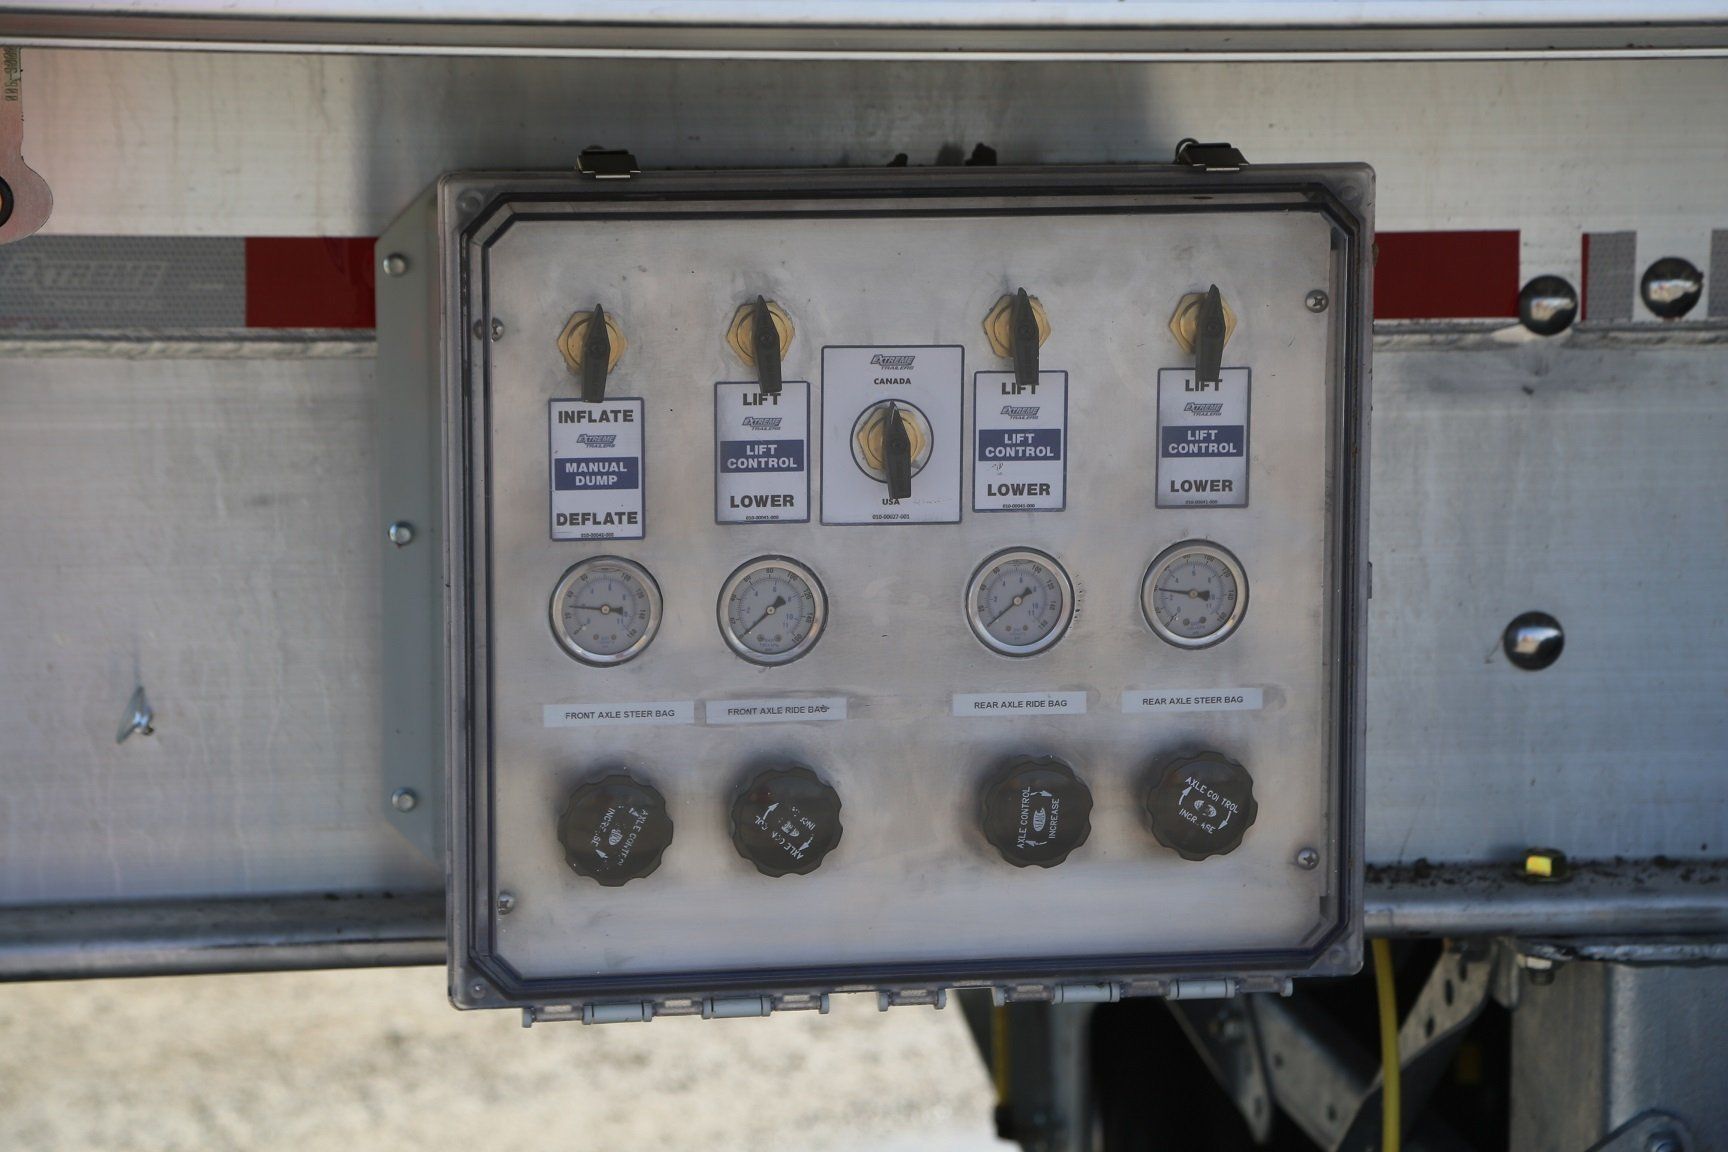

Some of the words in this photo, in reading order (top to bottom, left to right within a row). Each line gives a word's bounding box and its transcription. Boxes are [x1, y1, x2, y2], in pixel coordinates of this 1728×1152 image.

[871, 354, 915, 365] EXTREME
[1001, 382, 1037, 395] LIFT
[1185, 379, 1222, 392] LIFT
[742, 393, 781, 406] LIFT
[1000, 406, 1040, 416] EXTREME
[1184, 402, 1223, 412] EXTREME
[558, 410, 634, 424] INFLATE
[742, 417, 782, 427] EXTREME
[576, 434, 616, 445] EXTREME
[1004, 434, 1035, 444] LIFT
[1187, 430, 1218, 440] LIFT
[746, 445, 777, 455] LIFT
[985, 446, 1054, 457] CONTROL
[1168, 443, 1236, 453] CONTROL
[565, 462, 627, 472] MANUAL
[727, 458, 797, 468] CONTROL
[575, 475, 618, 486] DUMP
[1170, 480, 1233, 492] LOWER
[987, 483, 1050, 497] LOWER
[730, 494, 794, 508] LOWER
[556, 511, 638, 526] DEFLATE
[655, 709, 675, 718] BAG
[1185, 777, 1207, 794] AXLE
[1020, 786, 1030, 825] CONTROL
[633, 809, 648, 832] AXLE
[1049, 798, 1059, 839] INCREASE
[1179, 808, 1216, 834] INCRASE
[1016, 828, 1027, 848] AXLE
[784, 842, 804, 860] AXLE
